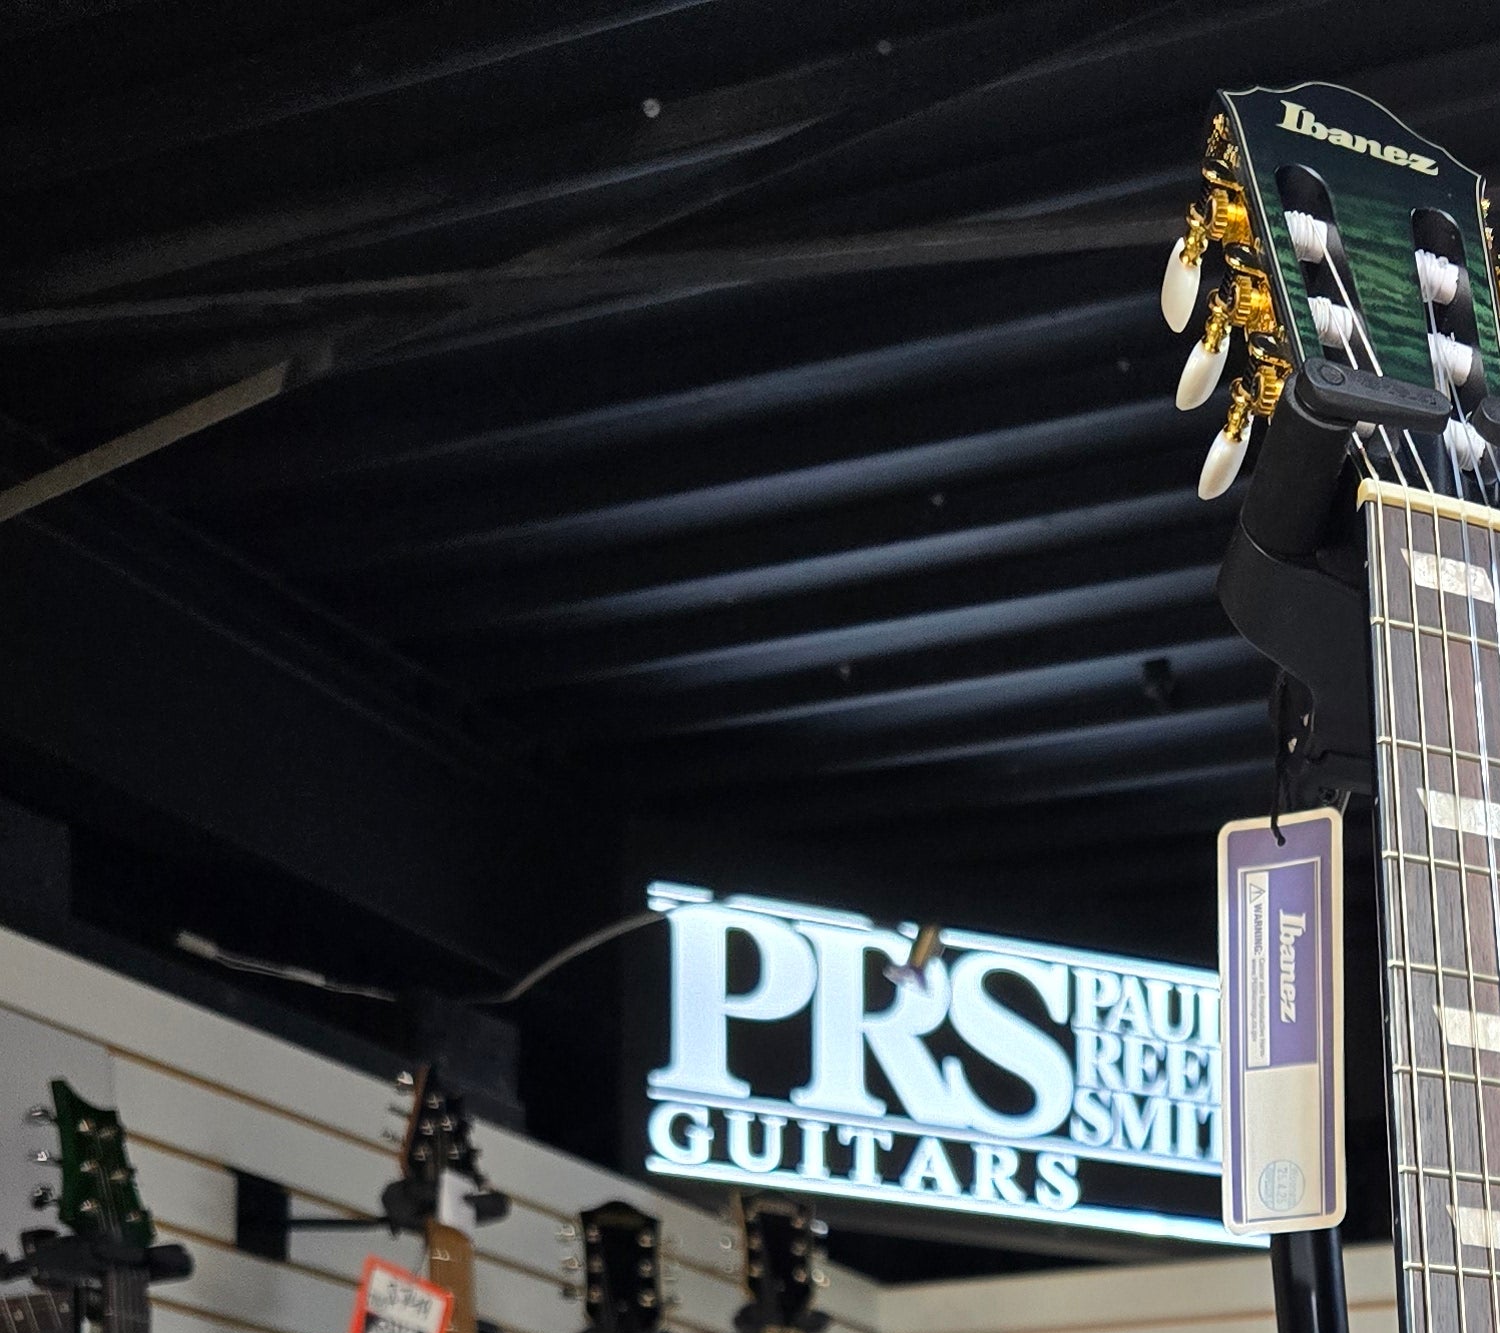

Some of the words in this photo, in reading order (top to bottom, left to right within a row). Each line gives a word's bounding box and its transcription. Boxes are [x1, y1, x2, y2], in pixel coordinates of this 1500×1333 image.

[1275, 99, 1439, 176] Ibanez
[1253, 903, 1263, 956] WARNING:
[1279, 908, 1307, 1024] Ibanez
[647, 903, 1075, 1140] PRS
[648, 1102, 1081, 1211] GUITARS
